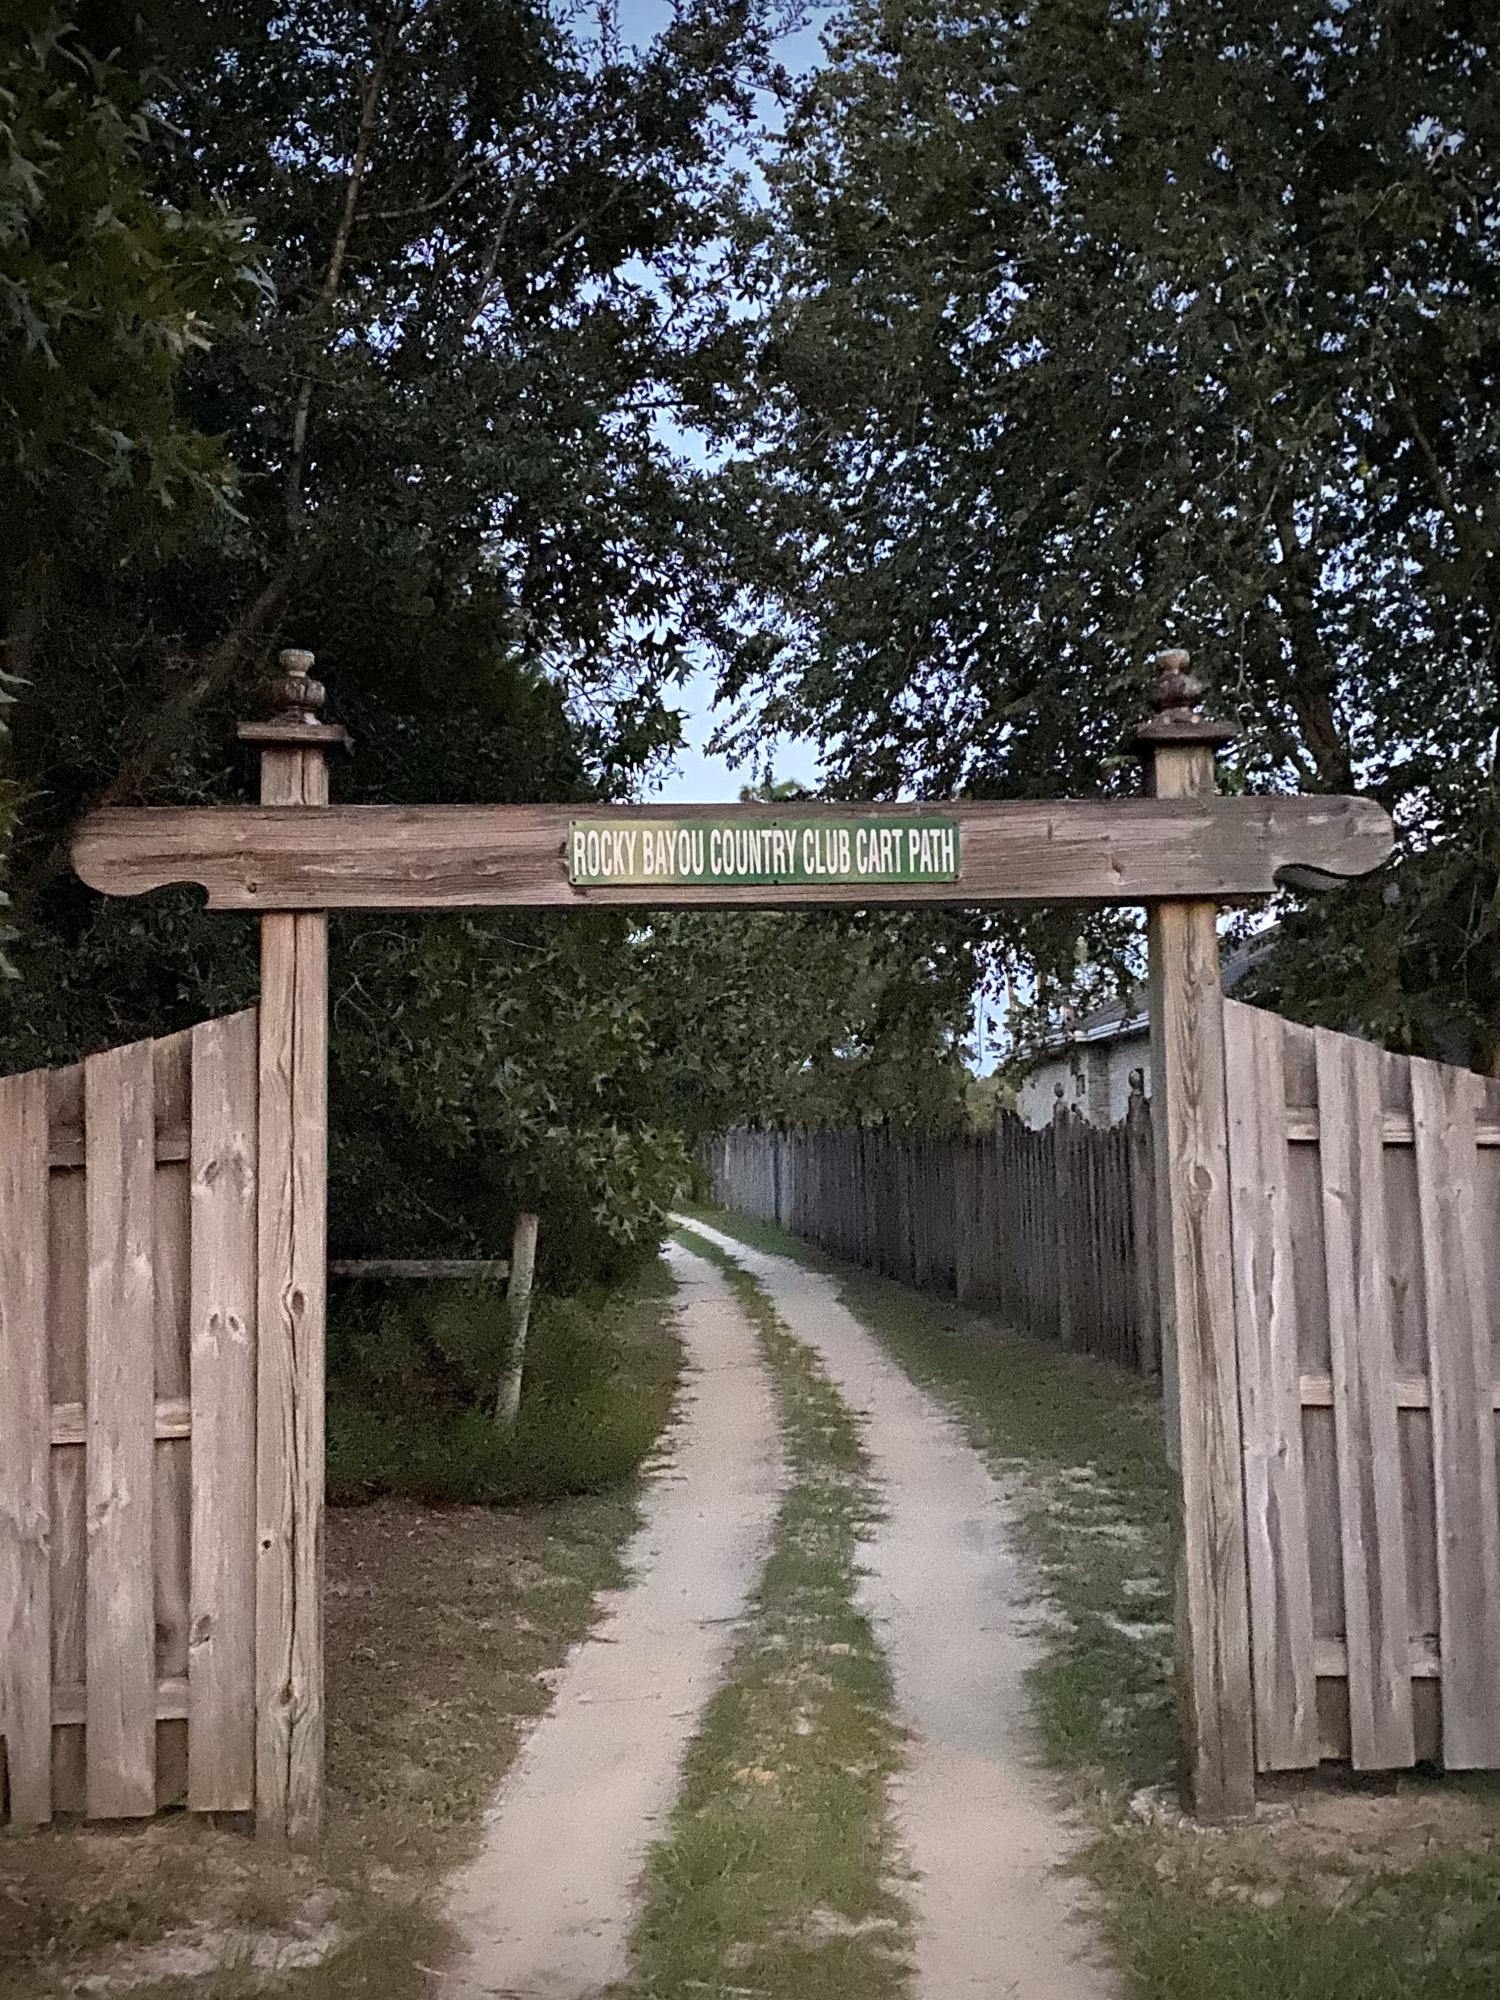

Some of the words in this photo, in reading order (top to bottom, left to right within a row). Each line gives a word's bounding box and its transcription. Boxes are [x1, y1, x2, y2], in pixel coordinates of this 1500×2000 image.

[573, 830, 637, 876] ROCKY
[643, 830, 704, 875] BAYOU
[710, 829, 797, 875] COUNTRY
[802, 828, 851, 874] CLUB
[856, 828, 903, 874] CART
[909, 828, 955, 873] PATH
